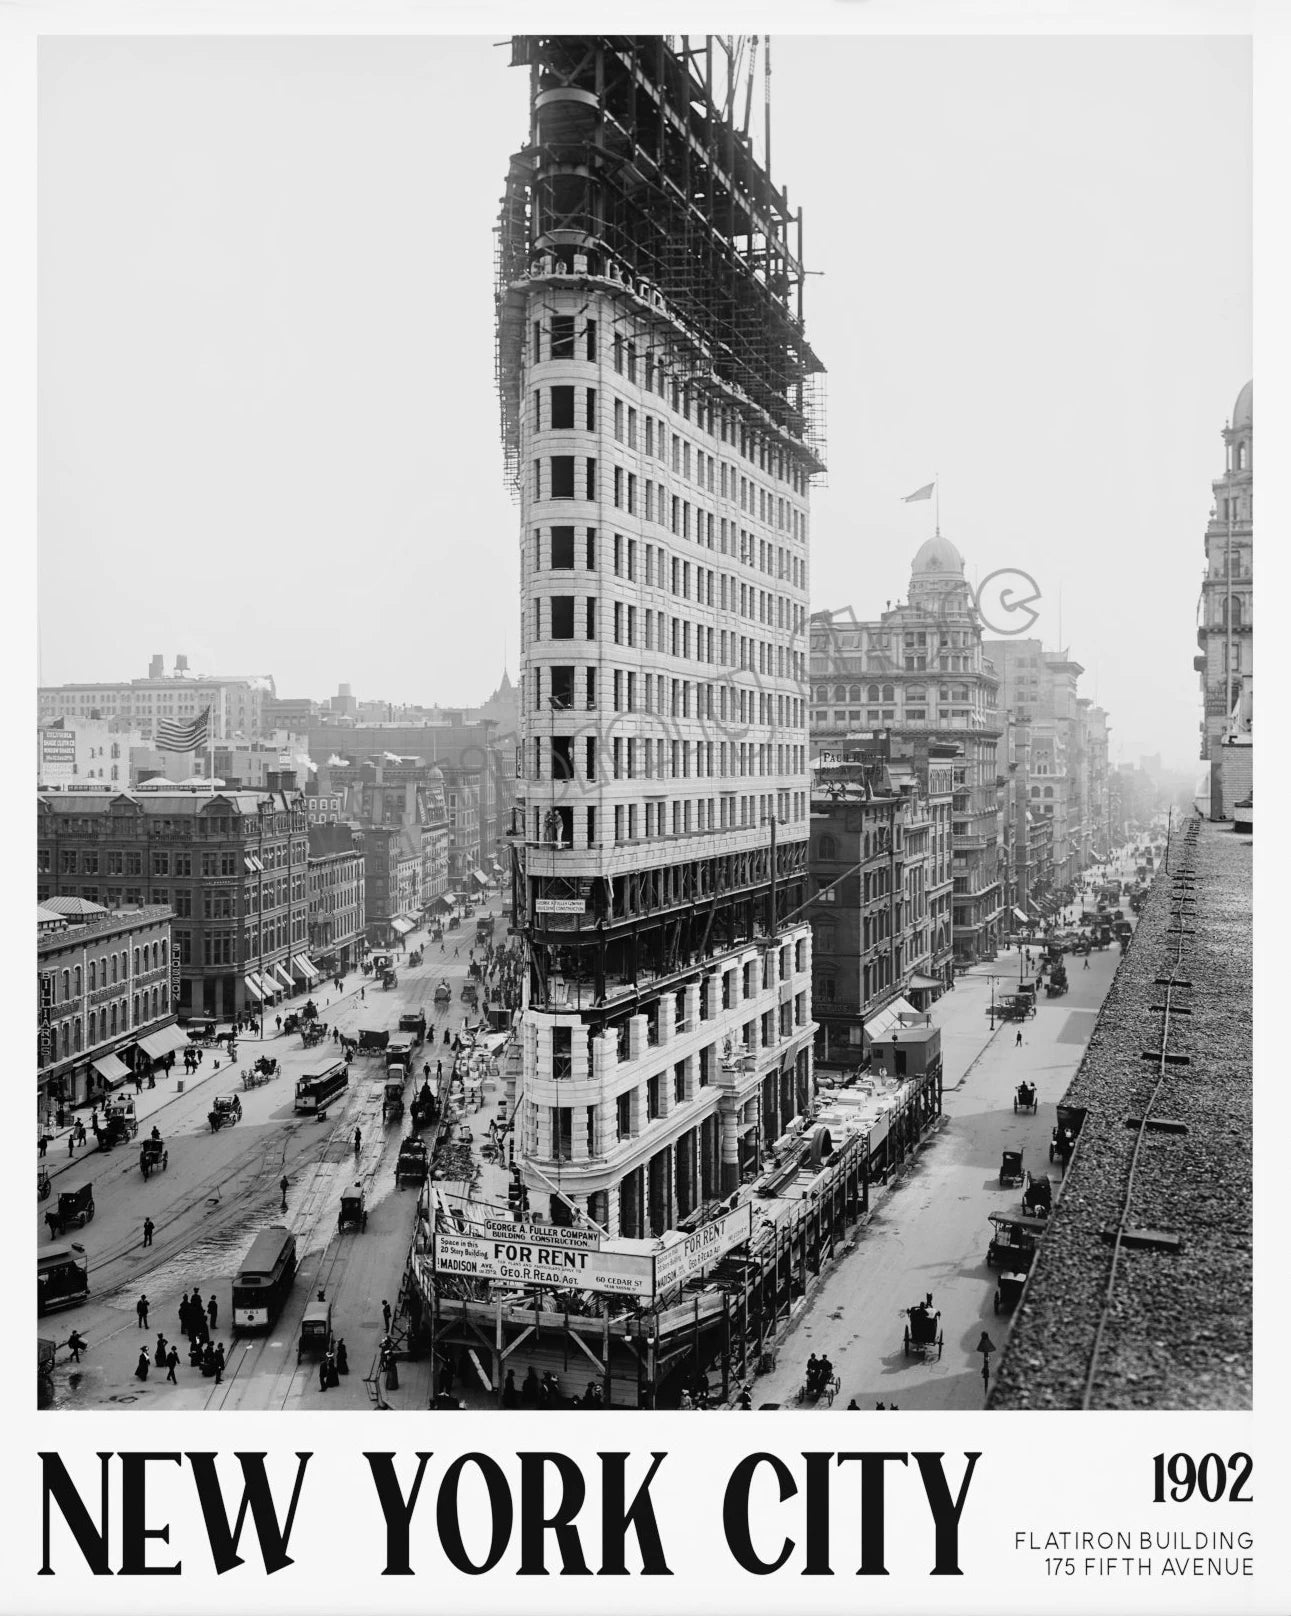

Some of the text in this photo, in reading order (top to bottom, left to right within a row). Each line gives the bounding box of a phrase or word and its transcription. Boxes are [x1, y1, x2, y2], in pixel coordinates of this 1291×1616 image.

[172, 943, 180, 1001] SLOSSON
[42, 971, 51, 1056] BILLIARDS
[486, 1221, 516, 1232] GEORGE
[530, 1226, 558, 1236] FULLER
[560, 1229, 598, 1241] COMPANY
[492, 1231, 526, 1240] BUILDING
[685, 1234, 700, 1256] FOR
[704, 1220, 725, 1245] RENT
[440, 1238, 460, 1247] Space
[450, 1247, 464, 1257] Story
[465, 1248, 489, 1260] Building
[494, 1244, 588, 1268] FOR RENT
[440, 1258, 476, 1272] MADISON
[608, 1278, 632, 1286] CEDAR
